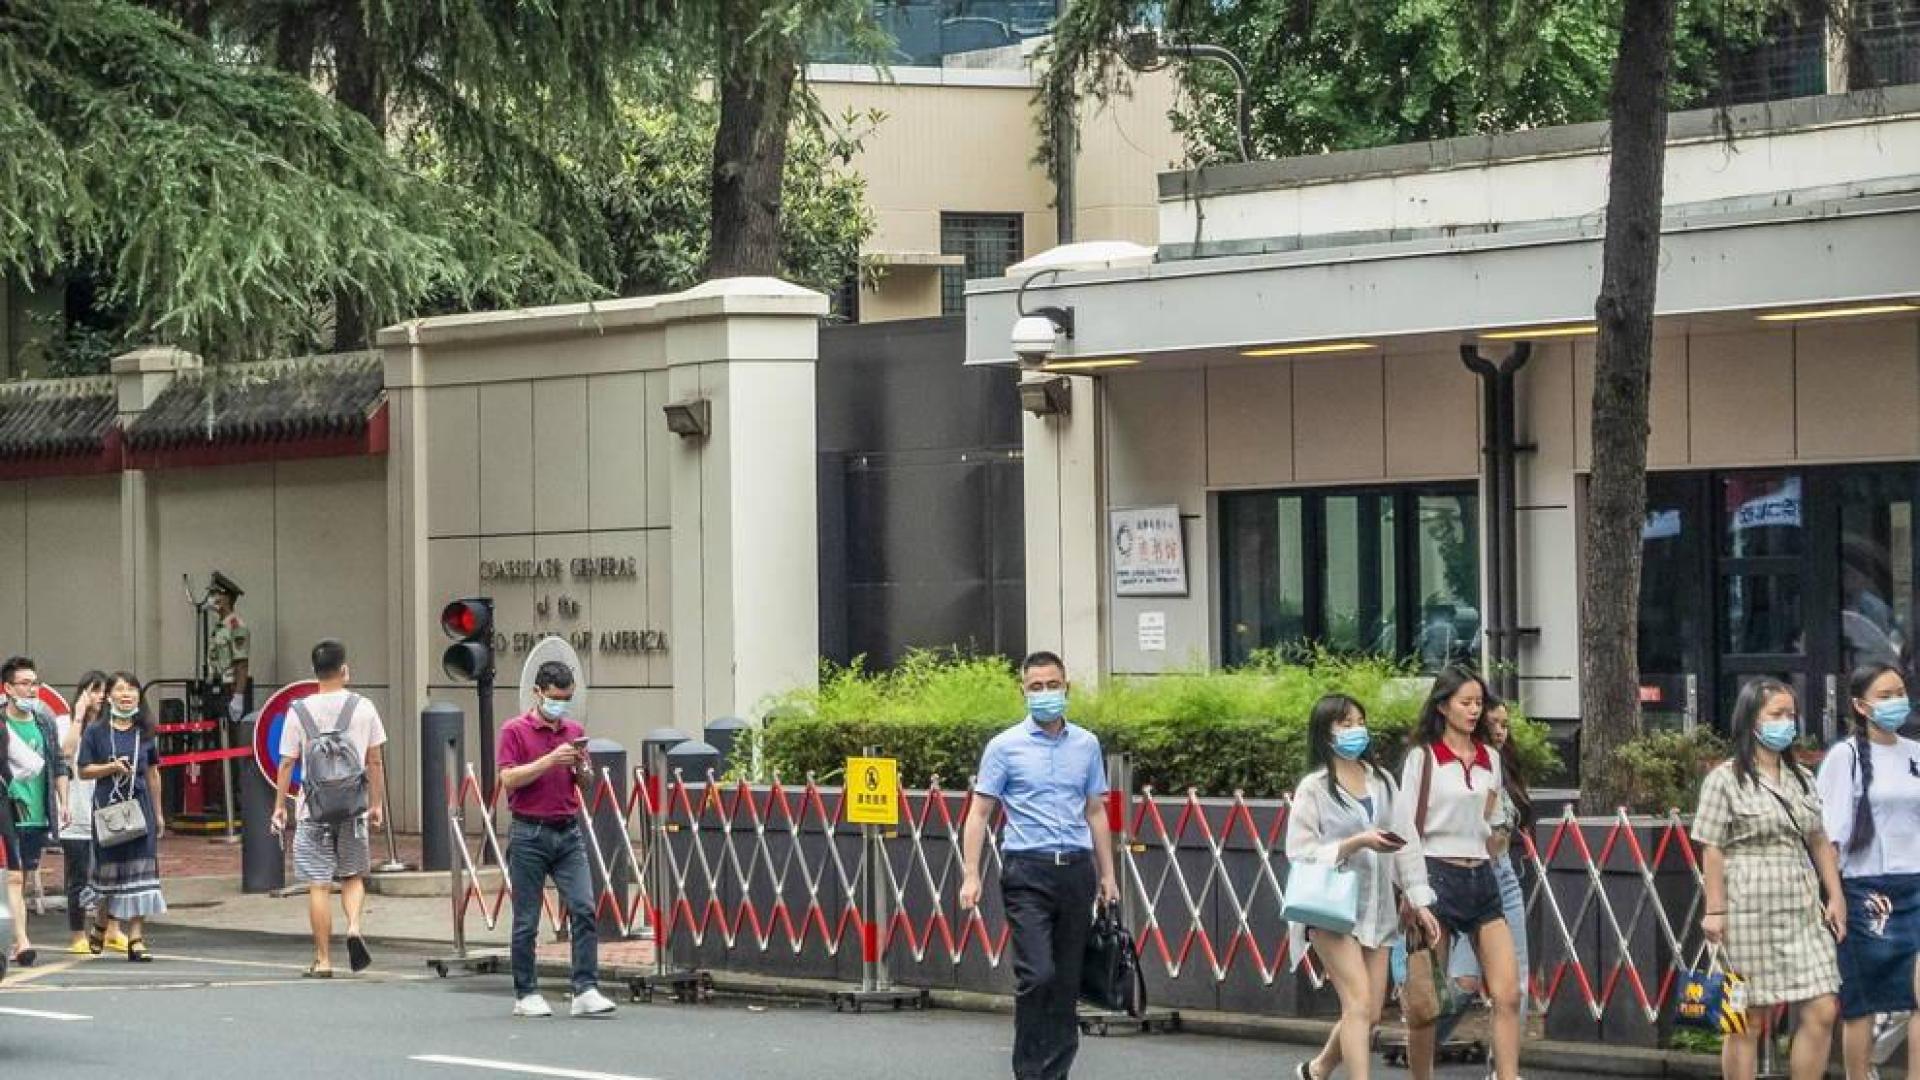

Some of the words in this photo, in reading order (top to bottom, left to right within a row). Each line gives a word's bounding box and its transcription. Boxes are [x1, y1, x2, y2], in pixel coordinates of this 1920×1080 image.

[570, 555, 637, 577] GENERAL
[536, 595, 549, 614] of
[558, 594, 580, 616] the
[600, 629, 668, 652] AMERICA
